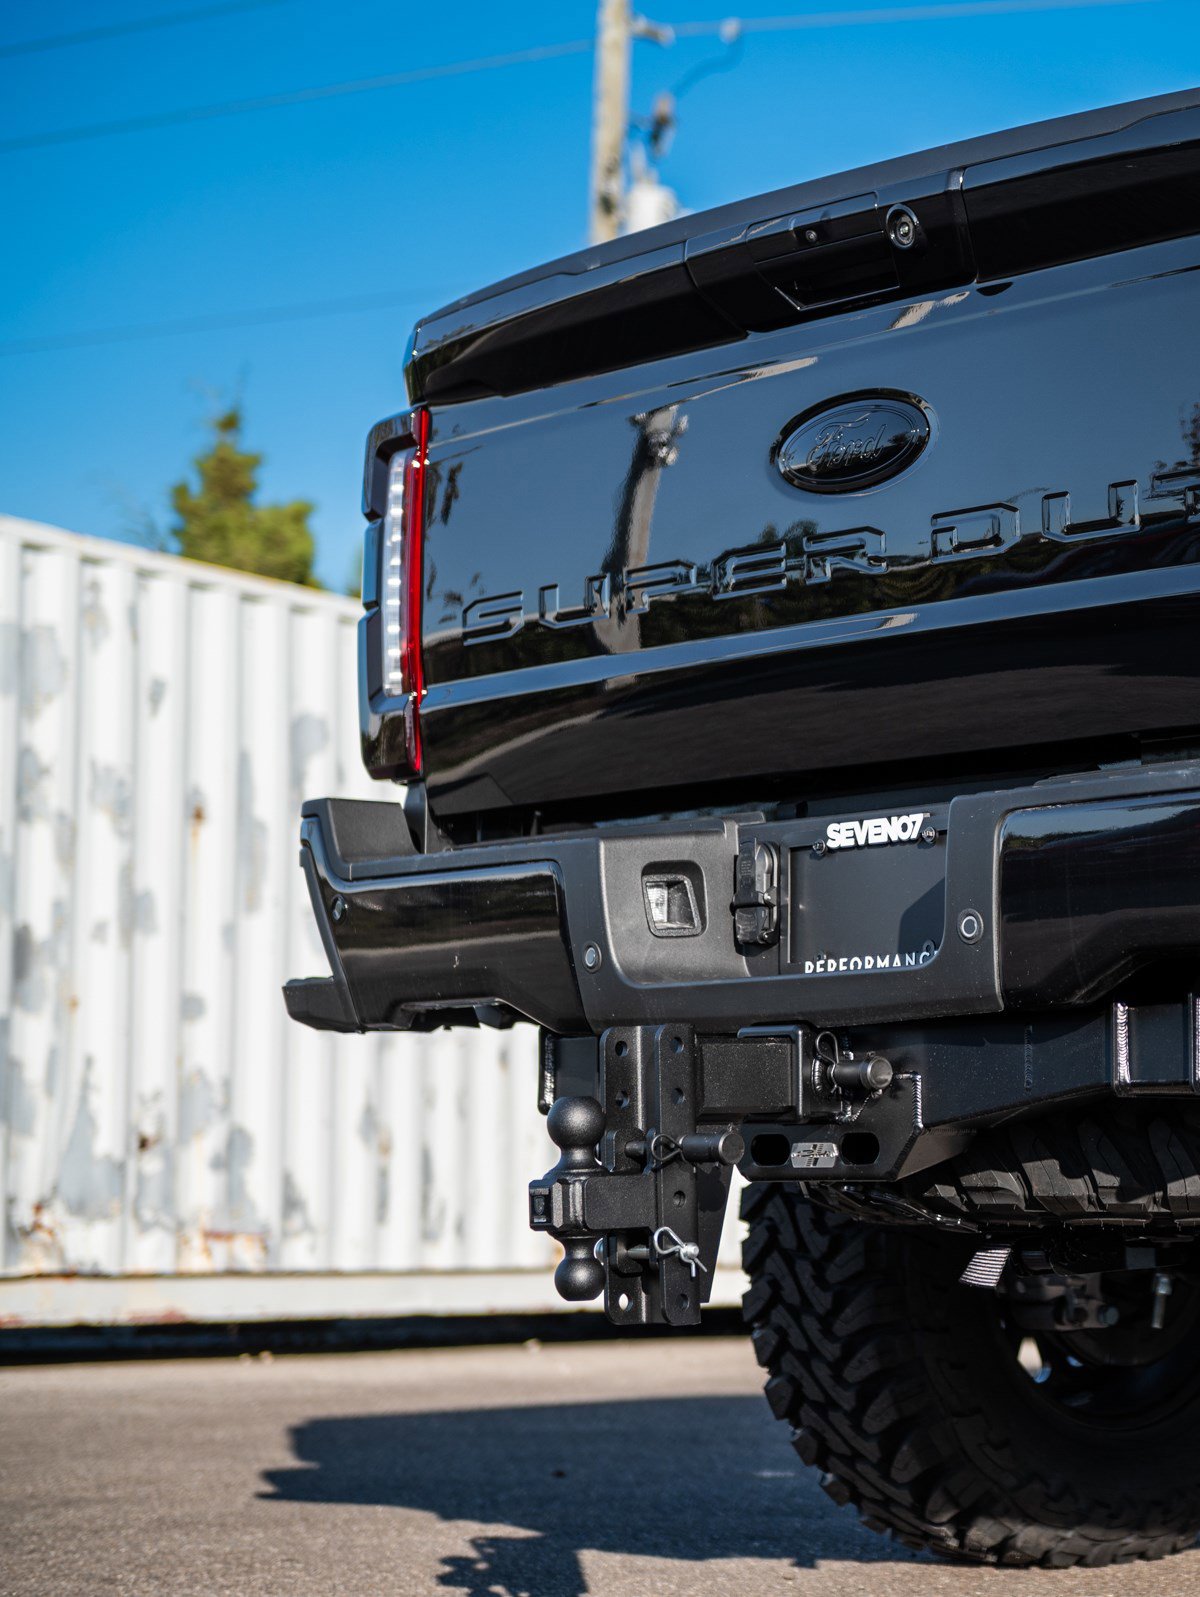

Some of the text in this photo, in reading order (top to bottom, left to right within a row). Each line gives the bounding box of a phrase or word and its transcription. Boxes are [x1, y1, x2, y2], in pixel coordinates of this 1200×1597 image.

[806, 412, 888, 471] Ford
[462, 525, 887, 646] SUPER
[804, 951, 938, 974] PERFORMANC
